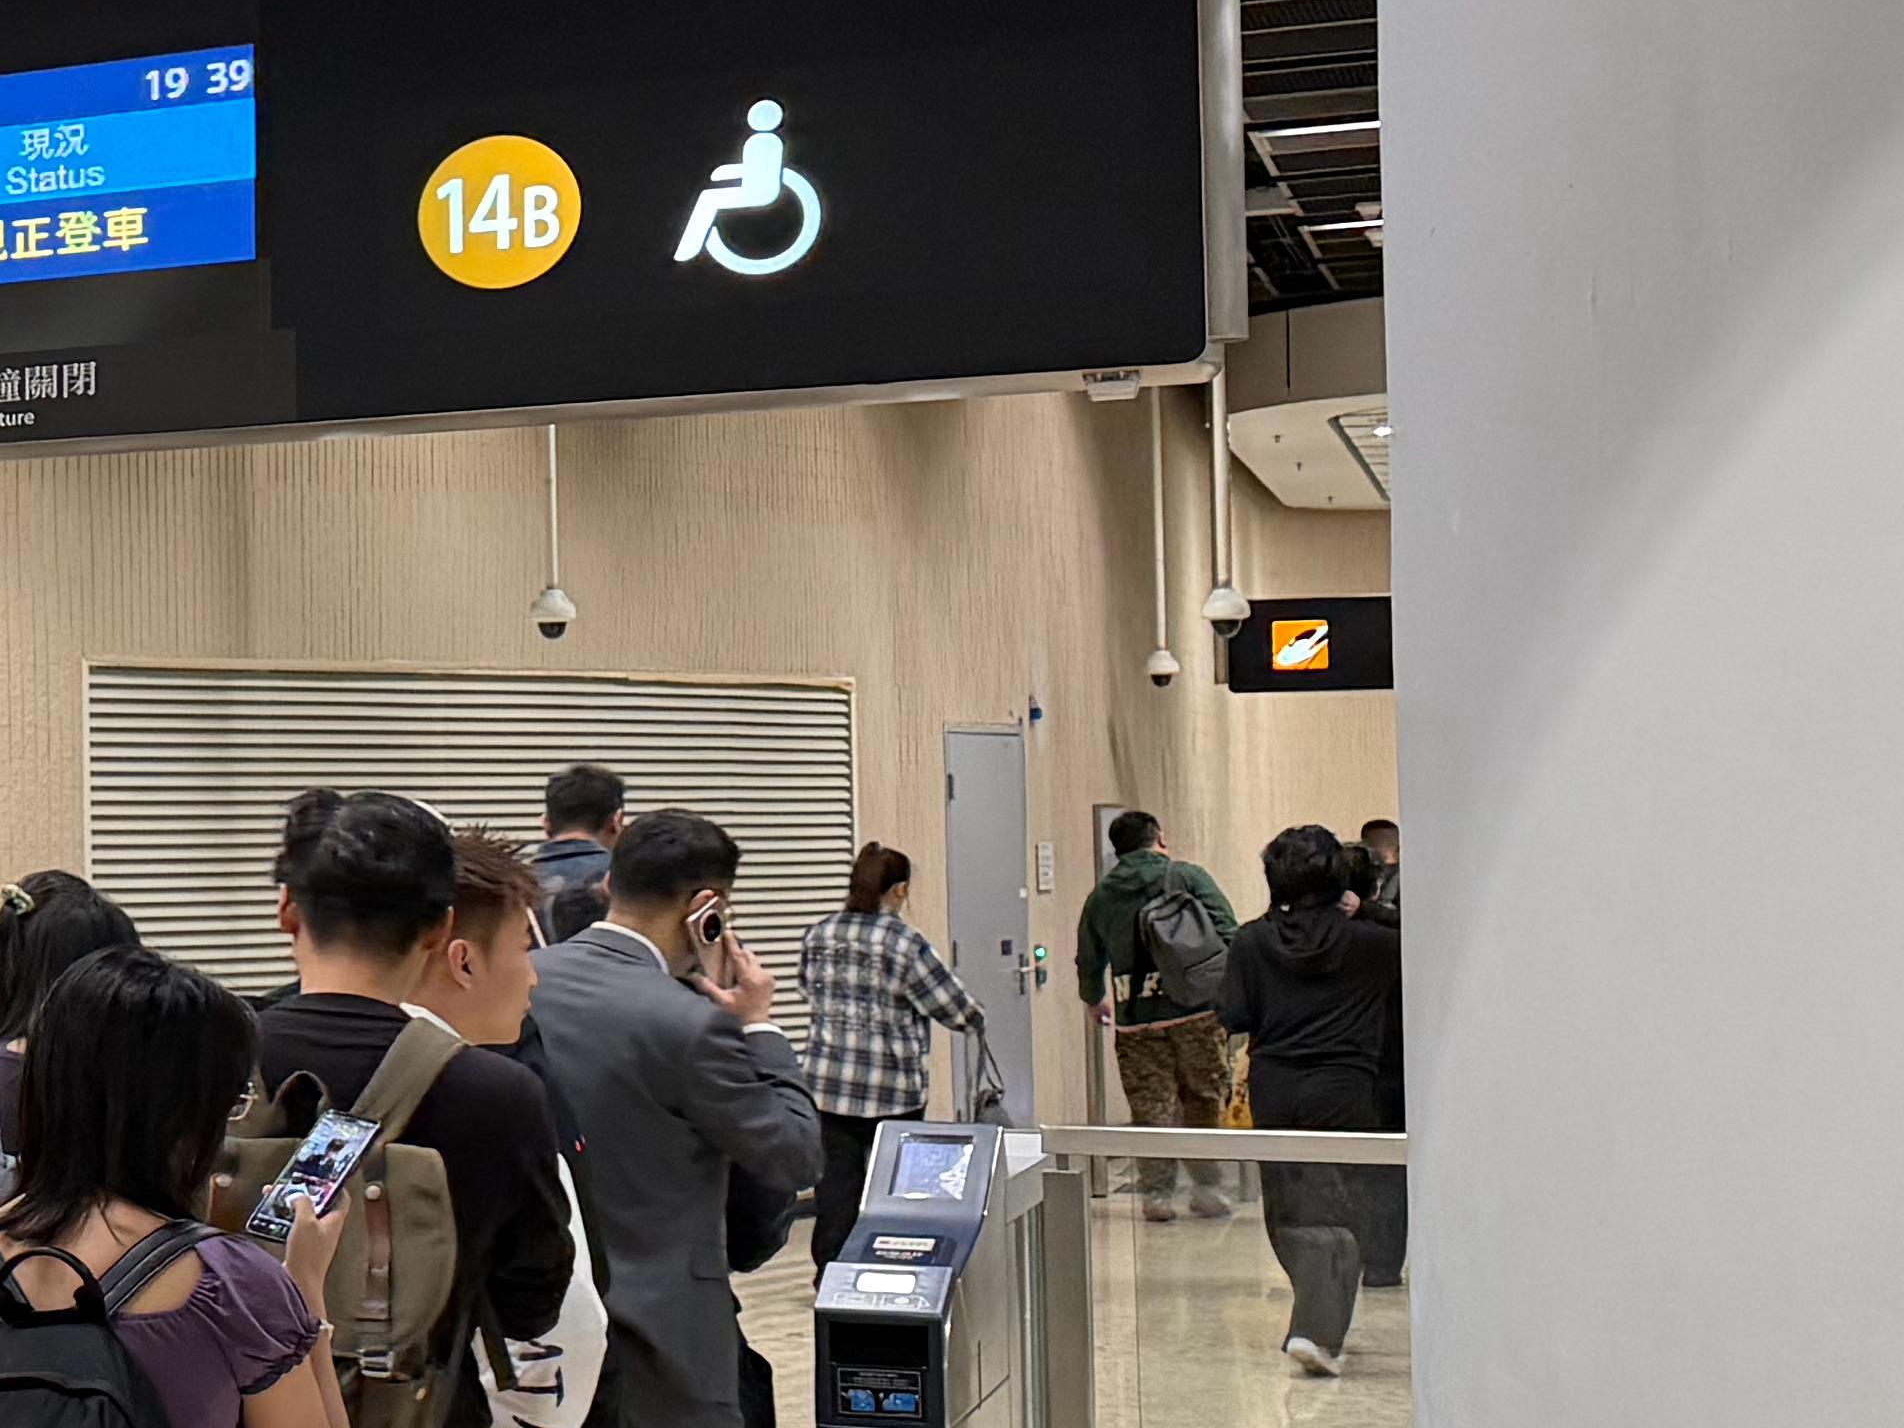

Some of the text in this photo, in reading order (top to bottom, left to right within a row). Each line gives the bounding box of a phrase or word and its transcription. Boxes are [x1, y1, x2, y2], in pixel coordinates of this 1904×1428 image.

[145, 58, 251, 102] 19 39
[19, 124, 89, 160] 現況
[5, 163, 105, 196] Status
[434, 173, 560, 254] 14B
